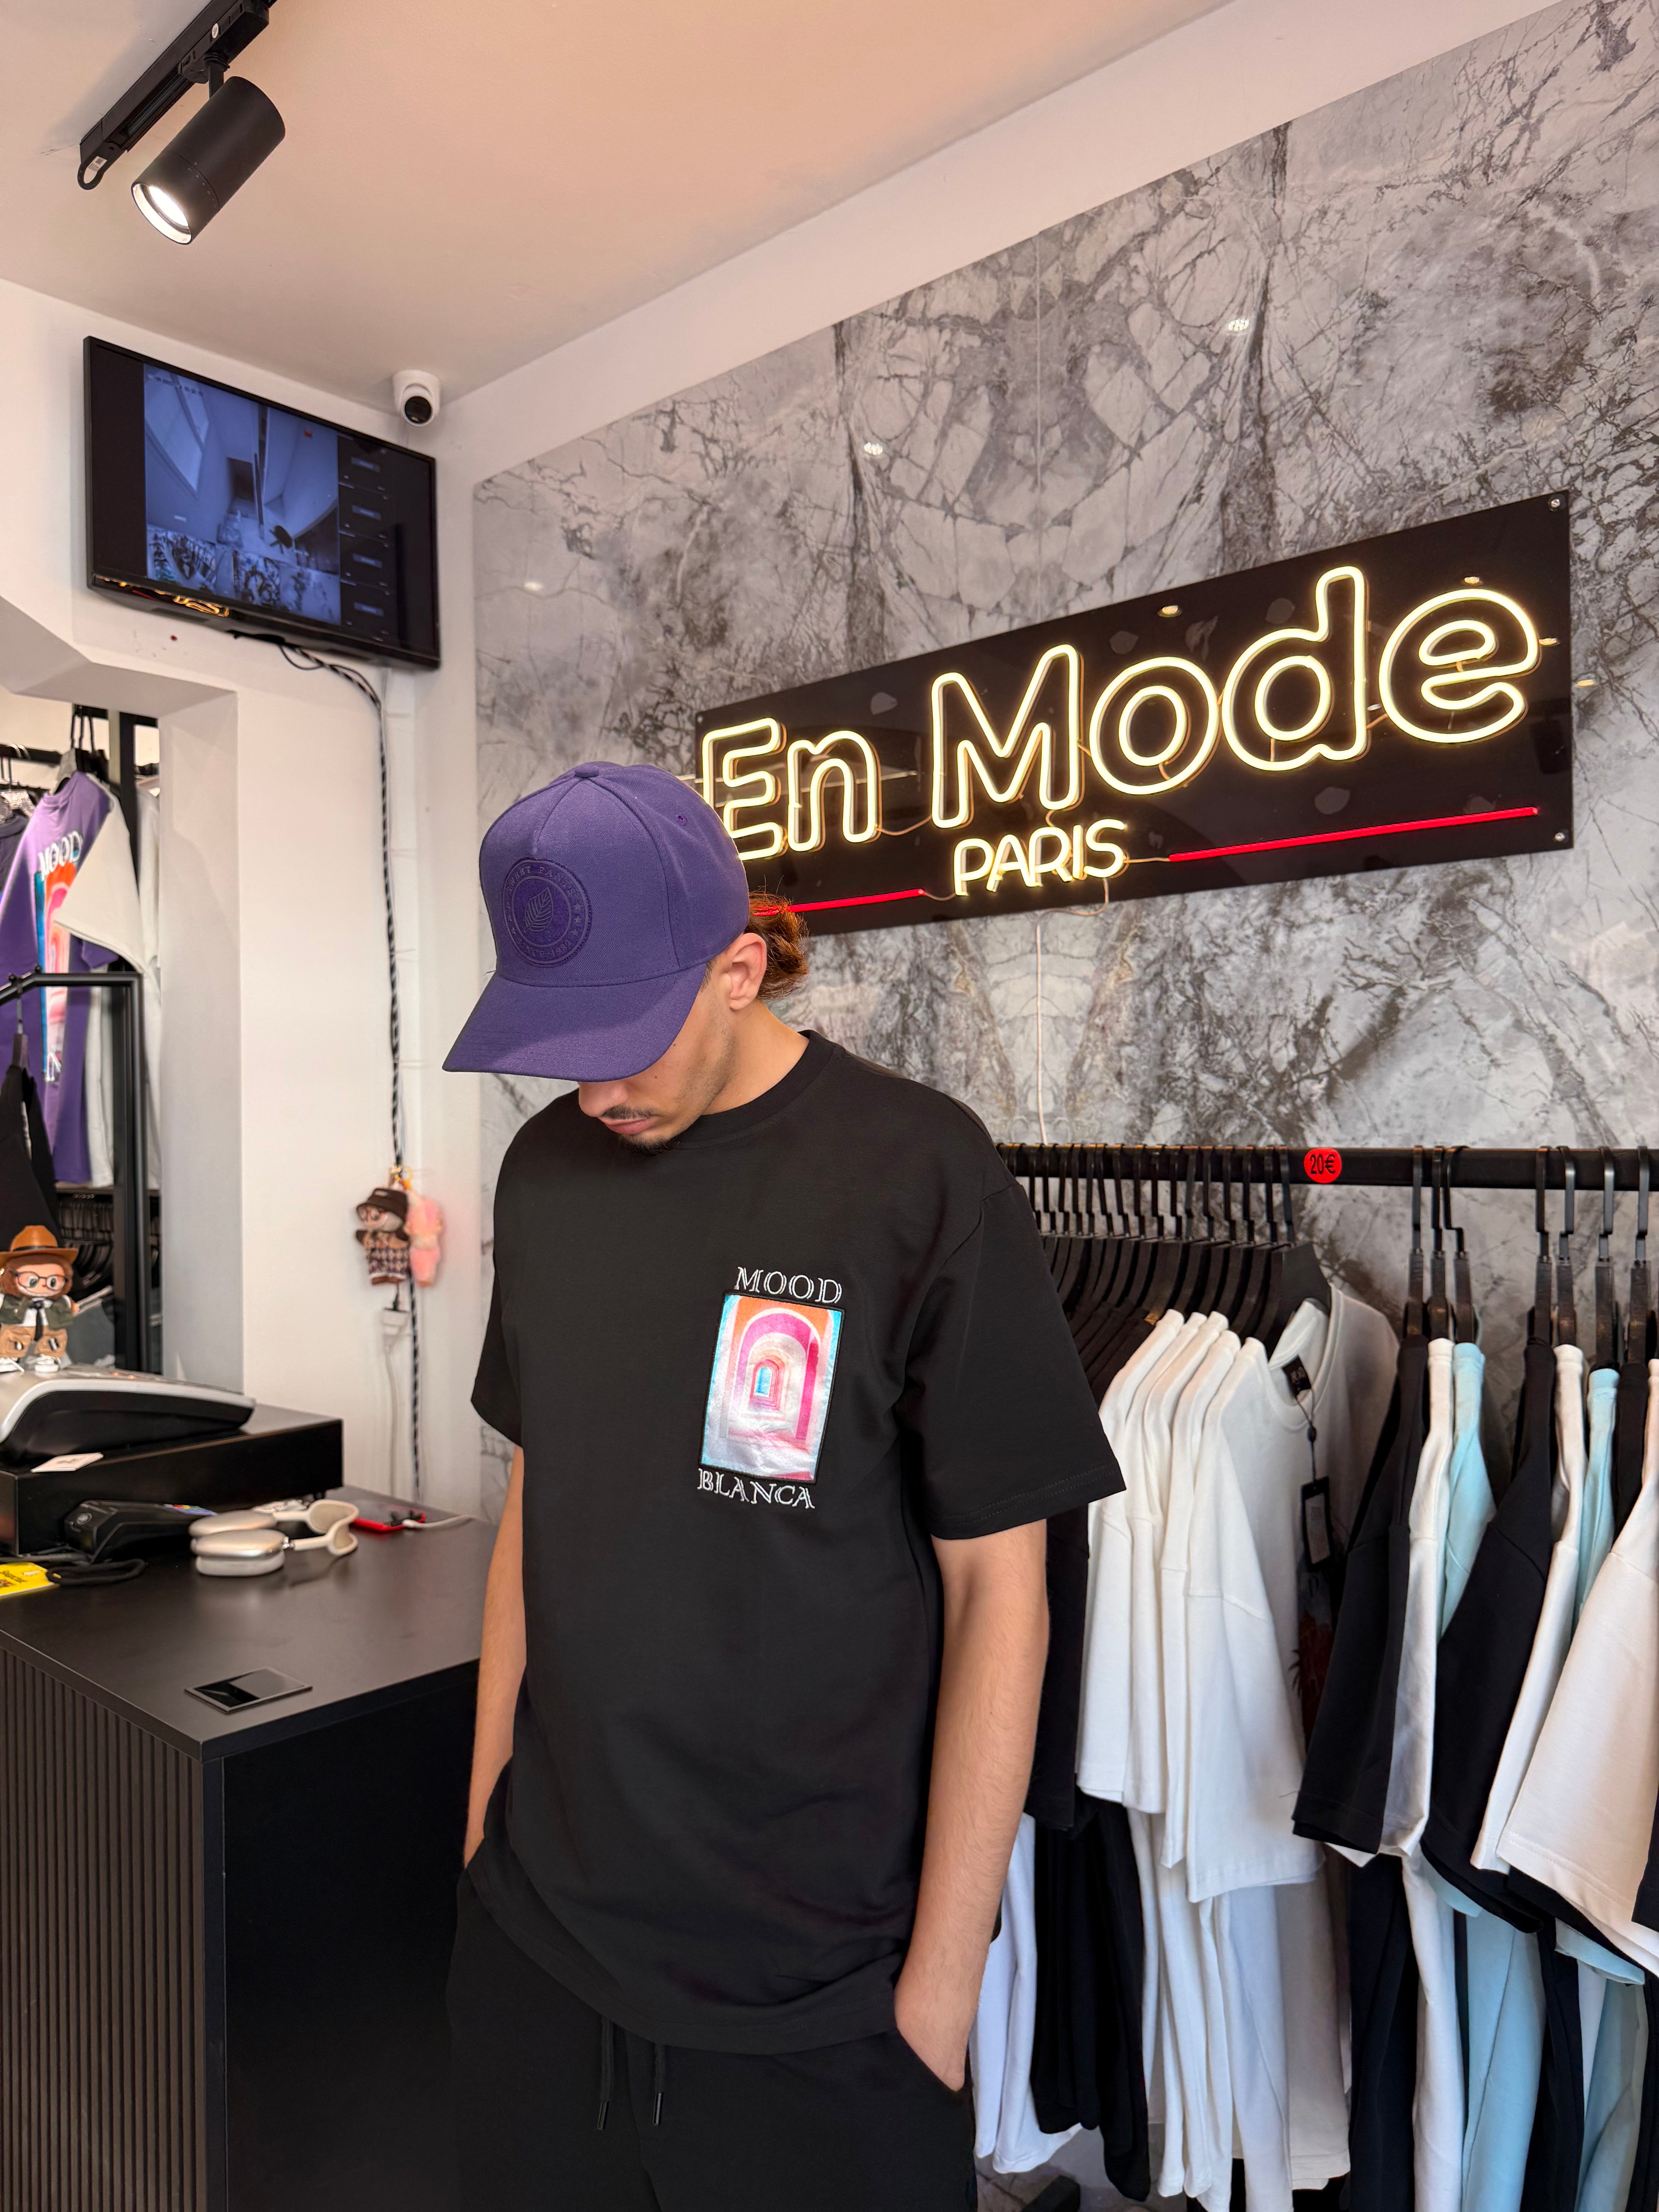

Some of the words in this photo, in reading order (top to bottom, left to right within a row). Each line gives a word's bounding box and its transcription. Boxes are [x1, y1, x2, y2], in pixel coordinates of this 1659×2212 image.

[702, 717, 880, 861] En
[931, 565, 1541, 829] Mode
[953, 818, 1126, 896] PARIS
[538, 867, 576, 895] PANTS
[1309, 1154, 1336, 1175] 20€
[733, 1266, 842, 1304] MOOD
[697, 1468, 815, 1509] BLANCA
